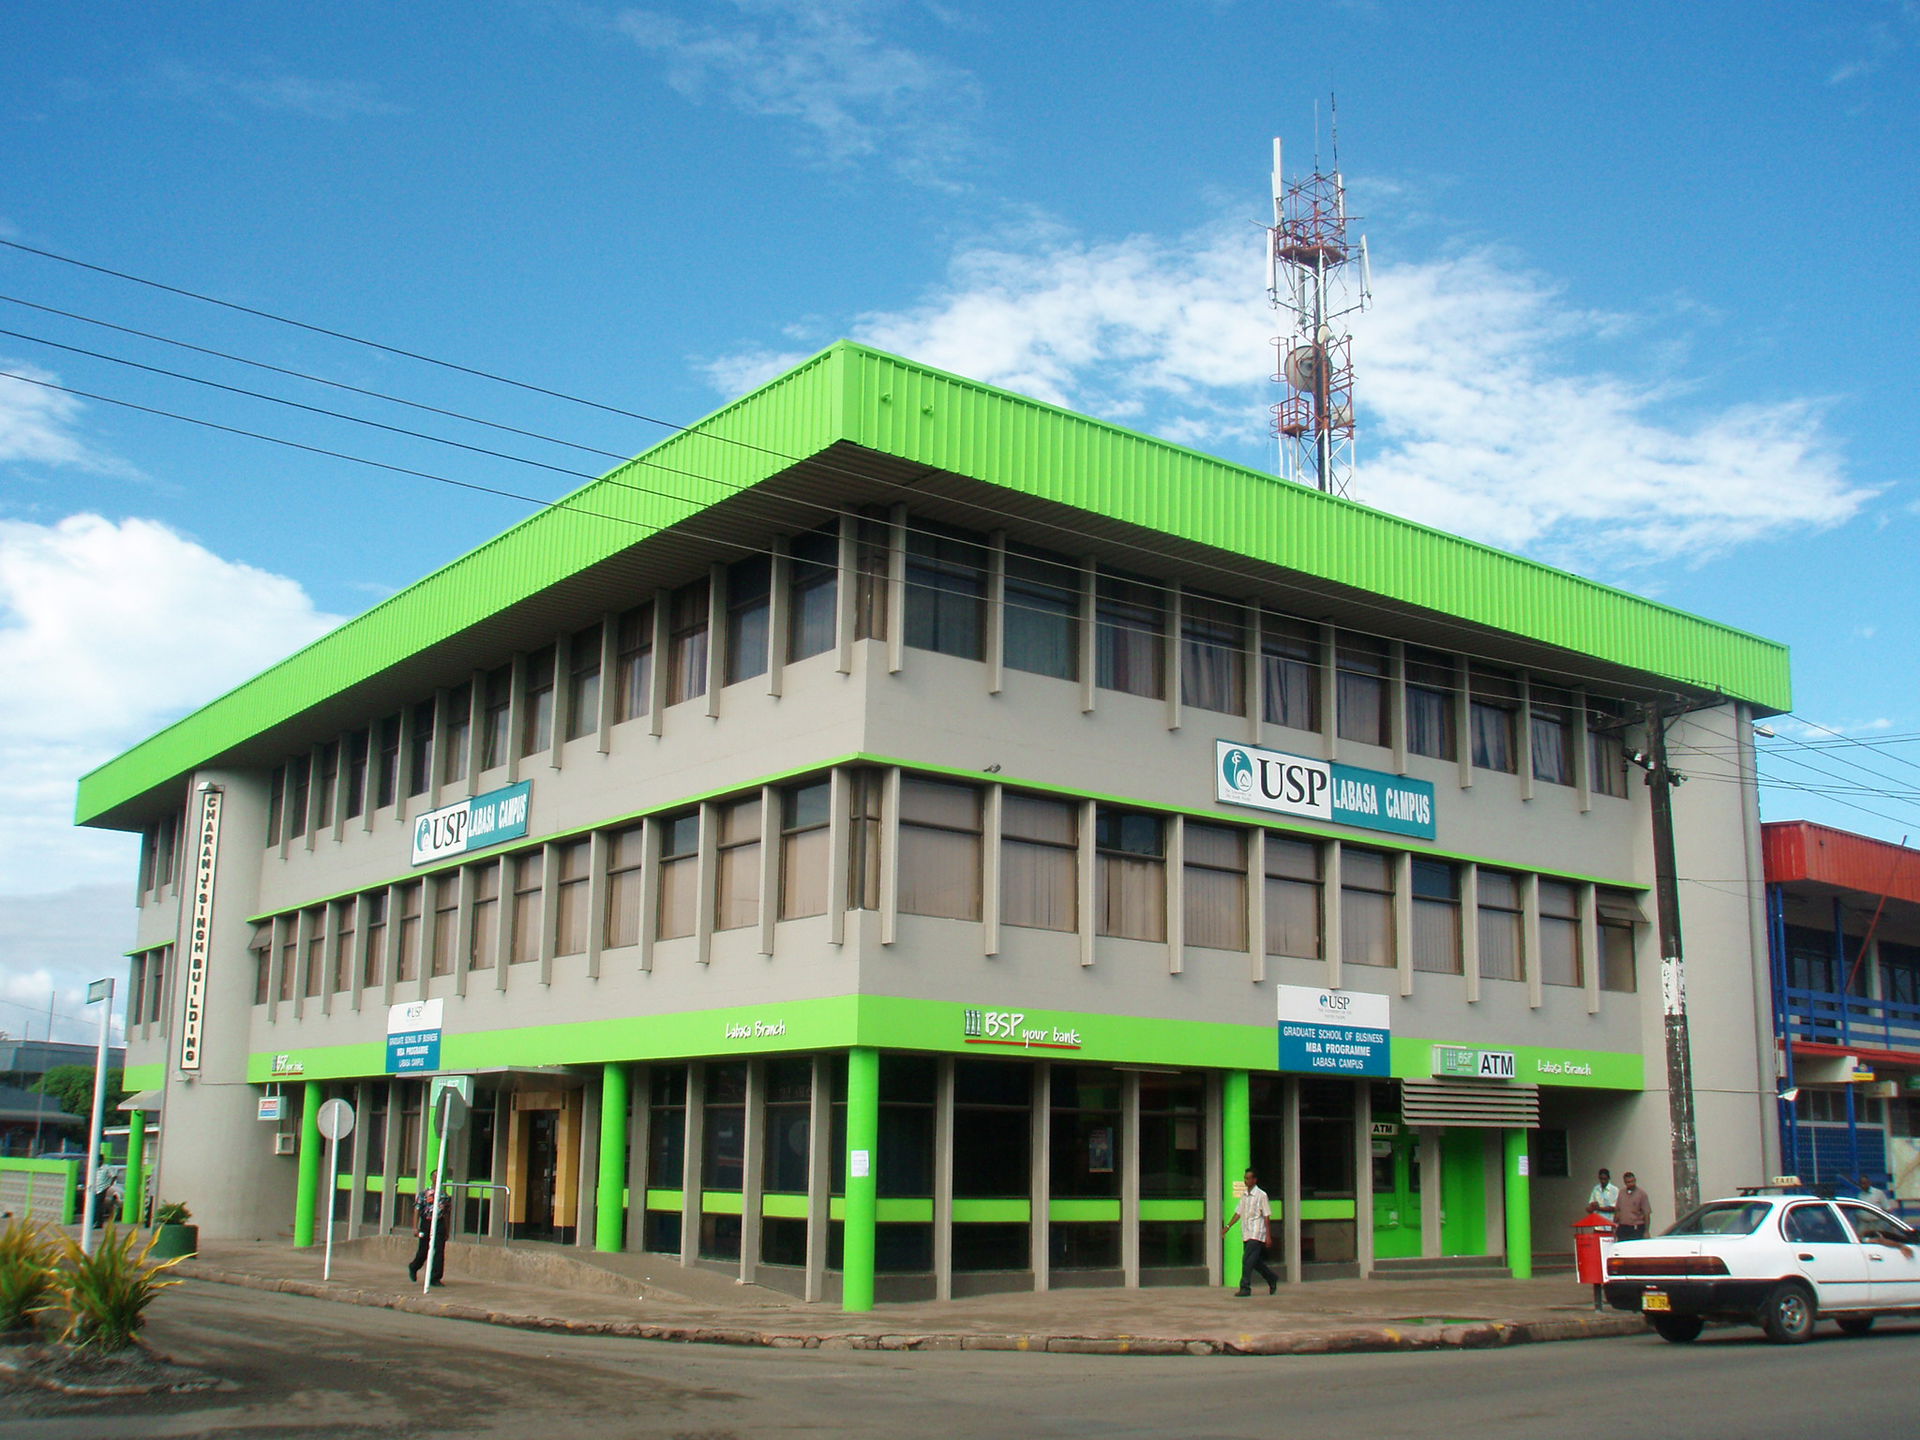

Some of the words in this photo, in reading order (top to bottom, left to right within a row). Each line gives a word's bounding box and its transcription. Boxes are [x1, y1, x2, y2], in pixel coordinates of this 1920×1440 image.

[1257, 757, 1327, 807] USP
[1332, 777, 1379, 815] LABASA
[1385, 787, 1430, 825] CAMPUS
[468, 803, 496, 838] LABASA
[498, 793, 527, 829] CAMPUS
[433, 809, 468, 849] USP
[194, 893, 209, 953] SINGH
[185, 958, 202, 1062] BUILDING
[1328, 995, 1350, 1010] USP
[726, 1023, 752, 1039] Labasa
[755, 1019, 786, 1037] Branch
[985, 1011, 1024, 1038] BSP
[1022, 1028, 1048, 1048] your
[1053, 1026, 1081, 1044] bank
[1283, 1026, 1316, 1039] GRADUATE
[1318, 1029, 1343, 1041] SCHOOL
[1344, 1031, 1353, 1042] OF
[1355, 1032, 1384, 1044] BUSINESS
[1305, 1042, 1322, 1053] MBA
[1325, 1043, 1371, 1057] PROGRAMME
[1312, 1057, 1336, 1067] LABASA
[1338, 1058, 1364, 1070] CAMPUS
[1481, 1054, 1513, 1076] ATM
[1537, 1059, 1562, 1075] Labasa
[1564, 1061, 1591, 1076] Branch
[1373, 1124, 1393, 1133] ATM
